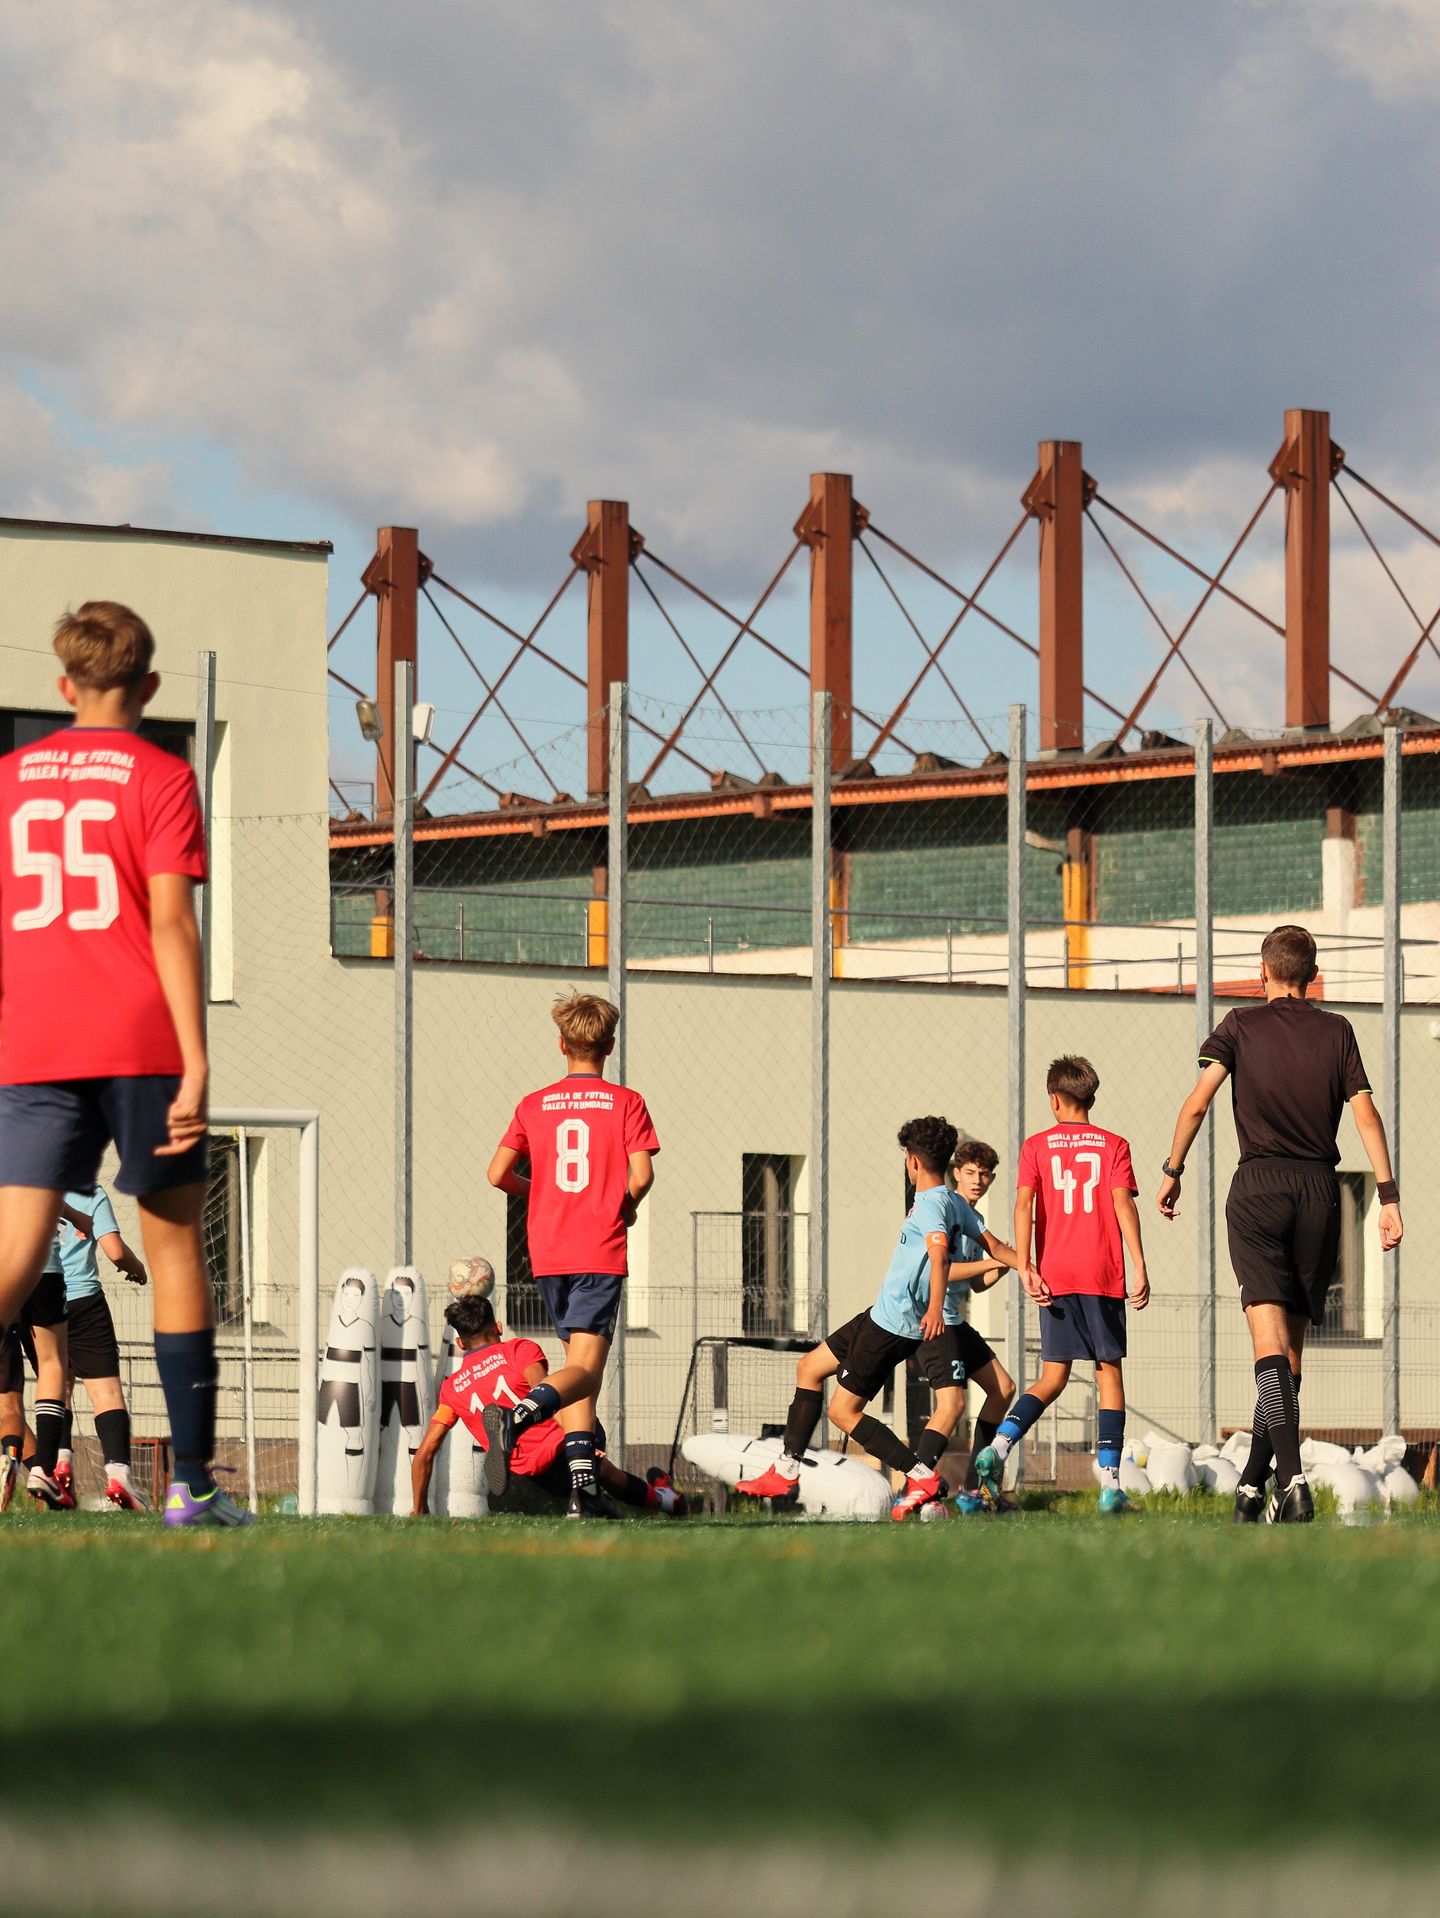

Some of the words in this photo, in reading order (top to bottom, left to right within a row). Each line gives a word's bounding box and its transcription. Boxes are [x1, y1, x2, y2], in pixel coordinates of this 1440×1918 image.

[71, 752, 89, 766] DE
[89, 750, 135, 768] FOTBAL
[19, 765, 59, 782] VALEA
[61, 766, 131, 785] FRUMOASEI
[11, 797, 120, 931] 55
[573, 1092, 583, 1100] DE
[585, 1091, 614, 1101] FOTBAL
[542, 1101, 566, 1111] VALEA
[568, 1101, 613, 1111] FRUMOASEI
[1048, 1141, 1068, 1149] VALEA
[1082, 1133, 1106, 1141] FOTBAL
[555, 1118, 590, 1194] 8
[1051, 1152, 1101, 1215] 47
[931, 1233, 941, 1243] C
[472, 1364, 483, 1373] DE
[482, 1353, 503, 1367] FOTBA
